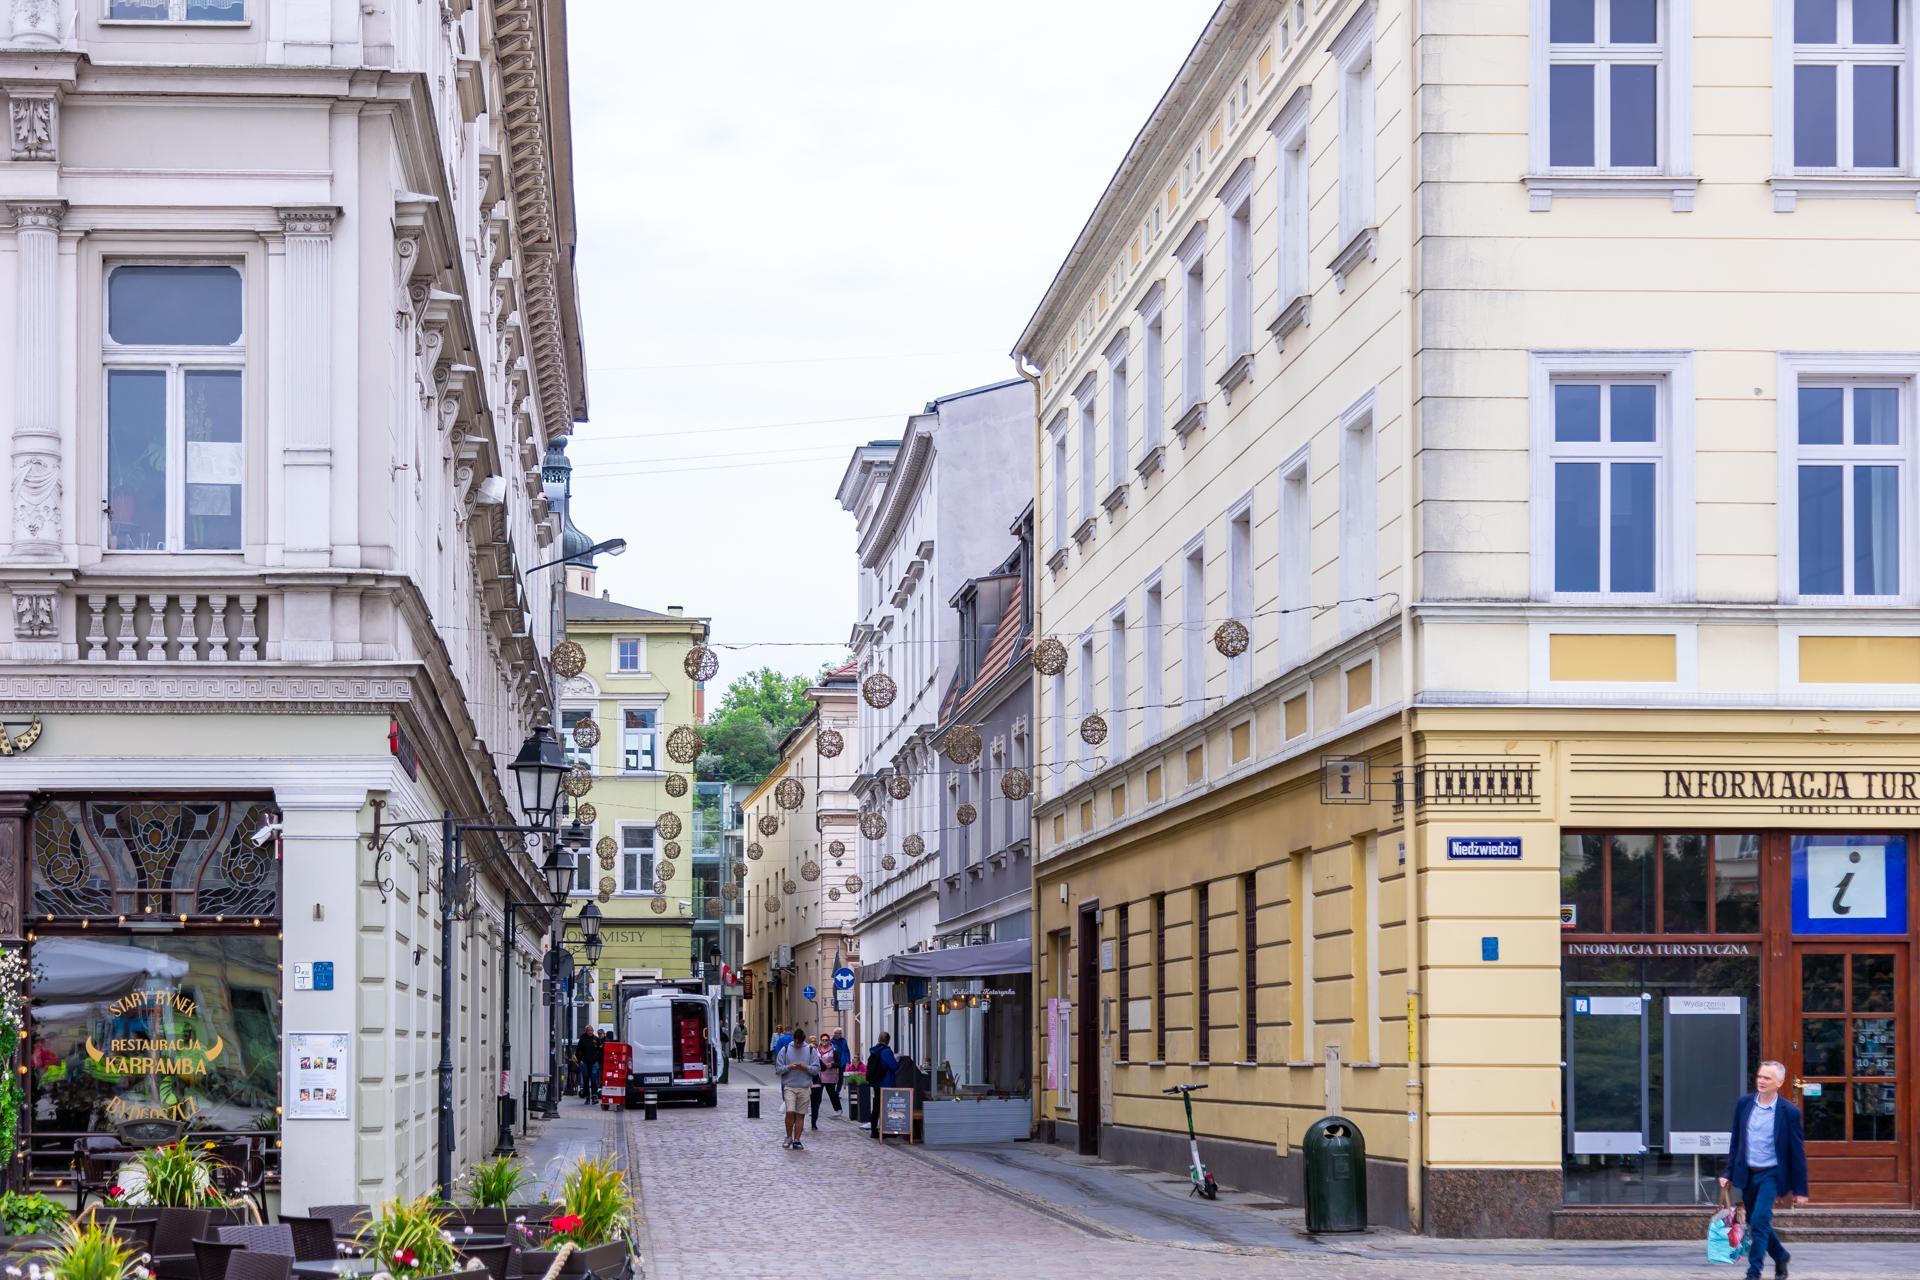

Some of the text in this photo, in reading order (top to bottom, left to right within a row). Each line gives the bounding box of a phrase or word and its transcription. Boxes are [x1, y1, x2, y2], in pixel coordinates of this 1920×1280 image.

[1663, 770, 1920, 799] INFORMACJA TUR
[1779, 805, 1839, 814] TOURIST
[1568, 944, 1750, 955] INFORMACJA TURYSTYCZNA
[602, 992, 611, 1000] 34
[109, 990, 199, 1018] STARY RYNEK
[110, 1039, 202, 1051] RESTAURACJA
[104, 1056, 207, 1075] KARRAMBA
